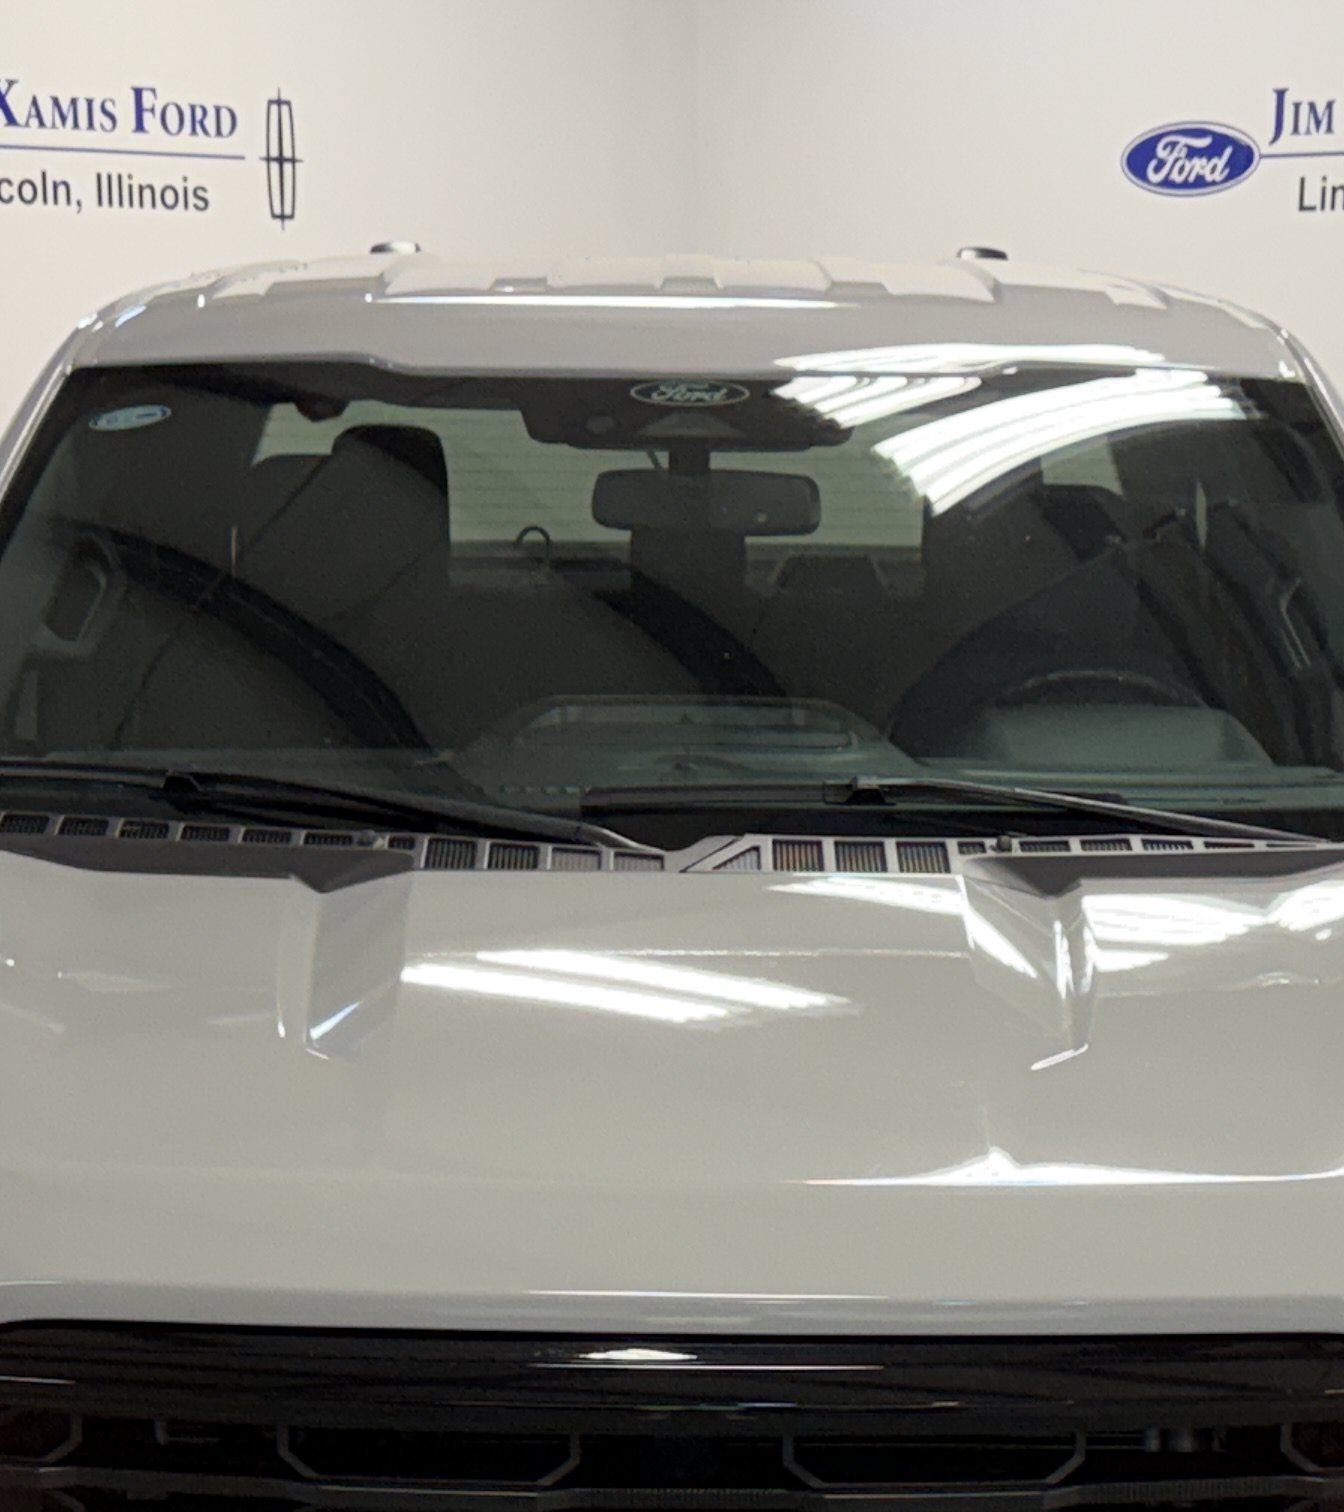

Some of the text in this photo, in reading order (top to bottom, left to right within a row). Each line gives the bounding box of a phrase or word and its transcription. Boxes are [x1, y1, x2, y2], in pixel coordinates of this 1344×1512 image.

[130, 86, 239, 139] FORD
[1268, 87, 1336, 145] JIM
[1146, 134, 1233, 186] Ford
[95, 172, 210, 212] Illinois
